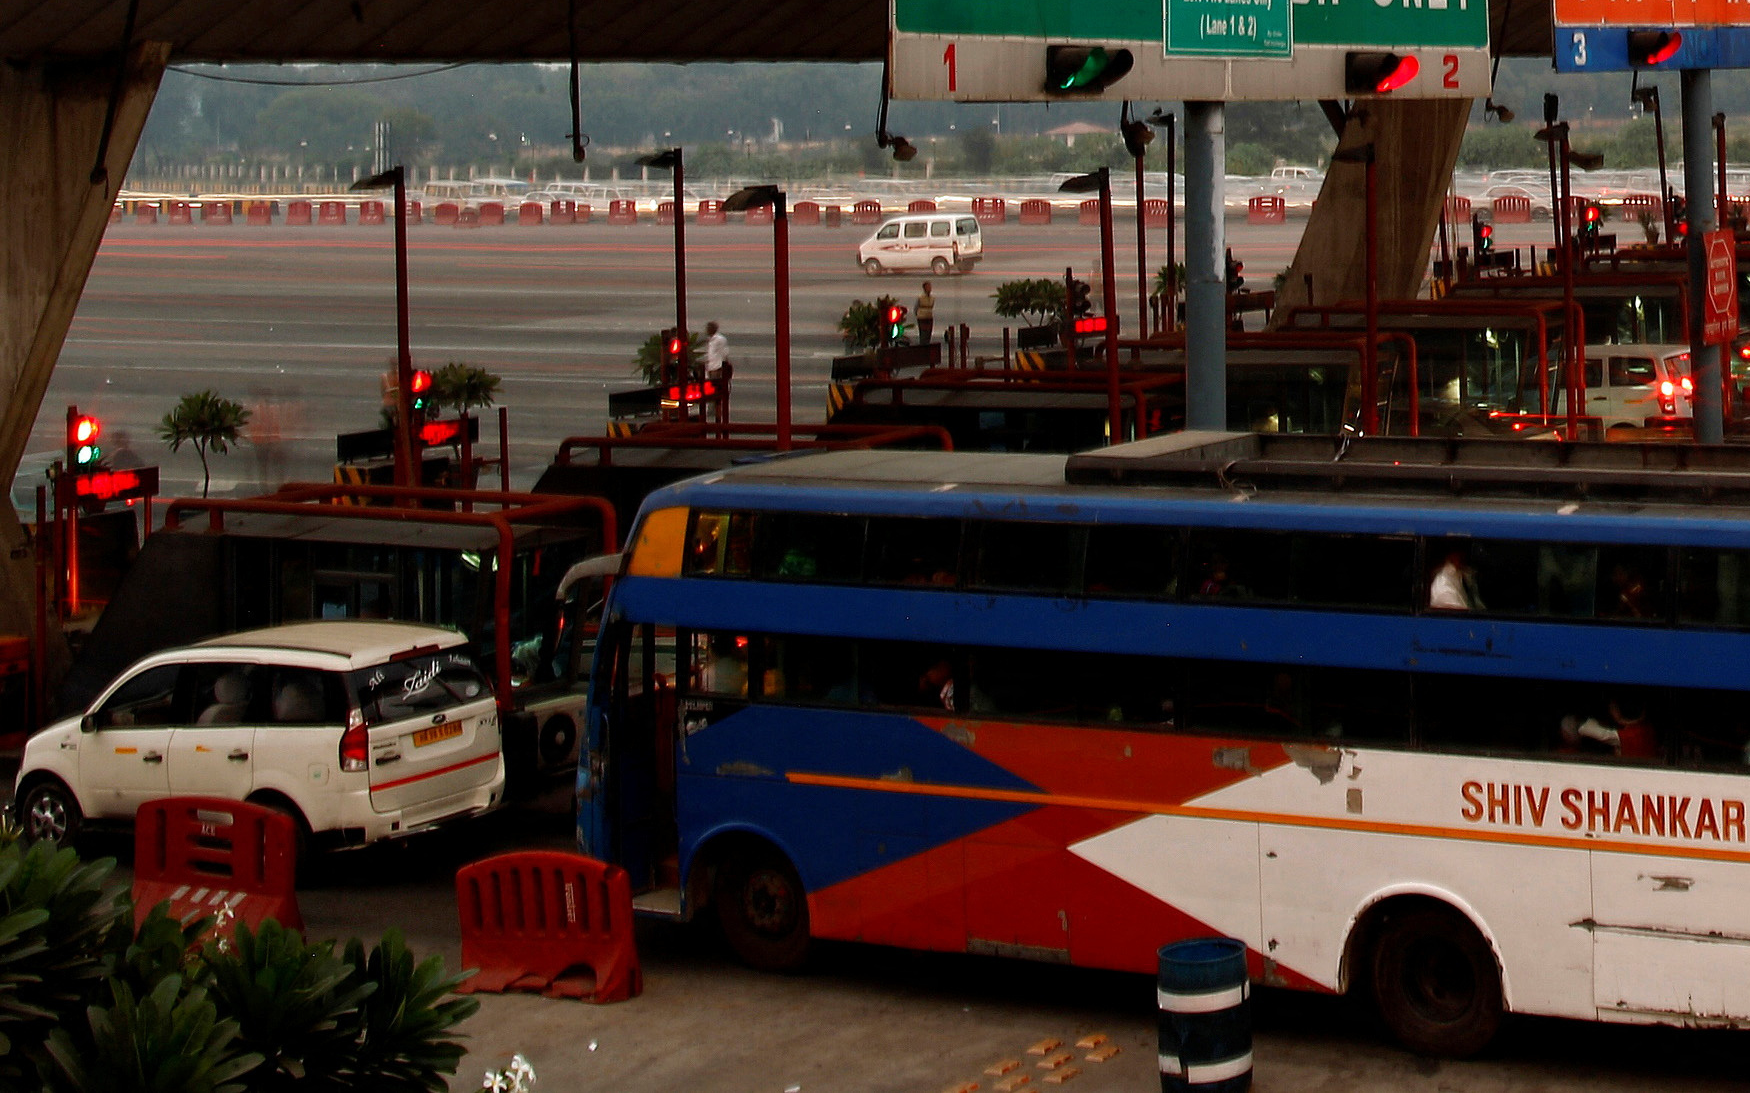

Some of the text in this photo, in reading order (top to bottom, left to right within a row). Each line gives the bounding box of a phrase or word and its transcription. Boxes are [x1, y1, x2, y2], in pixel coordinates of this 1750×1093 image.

[1230, 14, 1235, 36] 1
[1238, 15, 1245, 36] &
[1248, 15, 1257, 42] 2)
[1572, 32, 1587, 66] 3
[943, 43, 957, 93] 1
[1442, 54, 1459, 89] 2
[1461, 781, 1746, 843] SHIV SHANKAR
